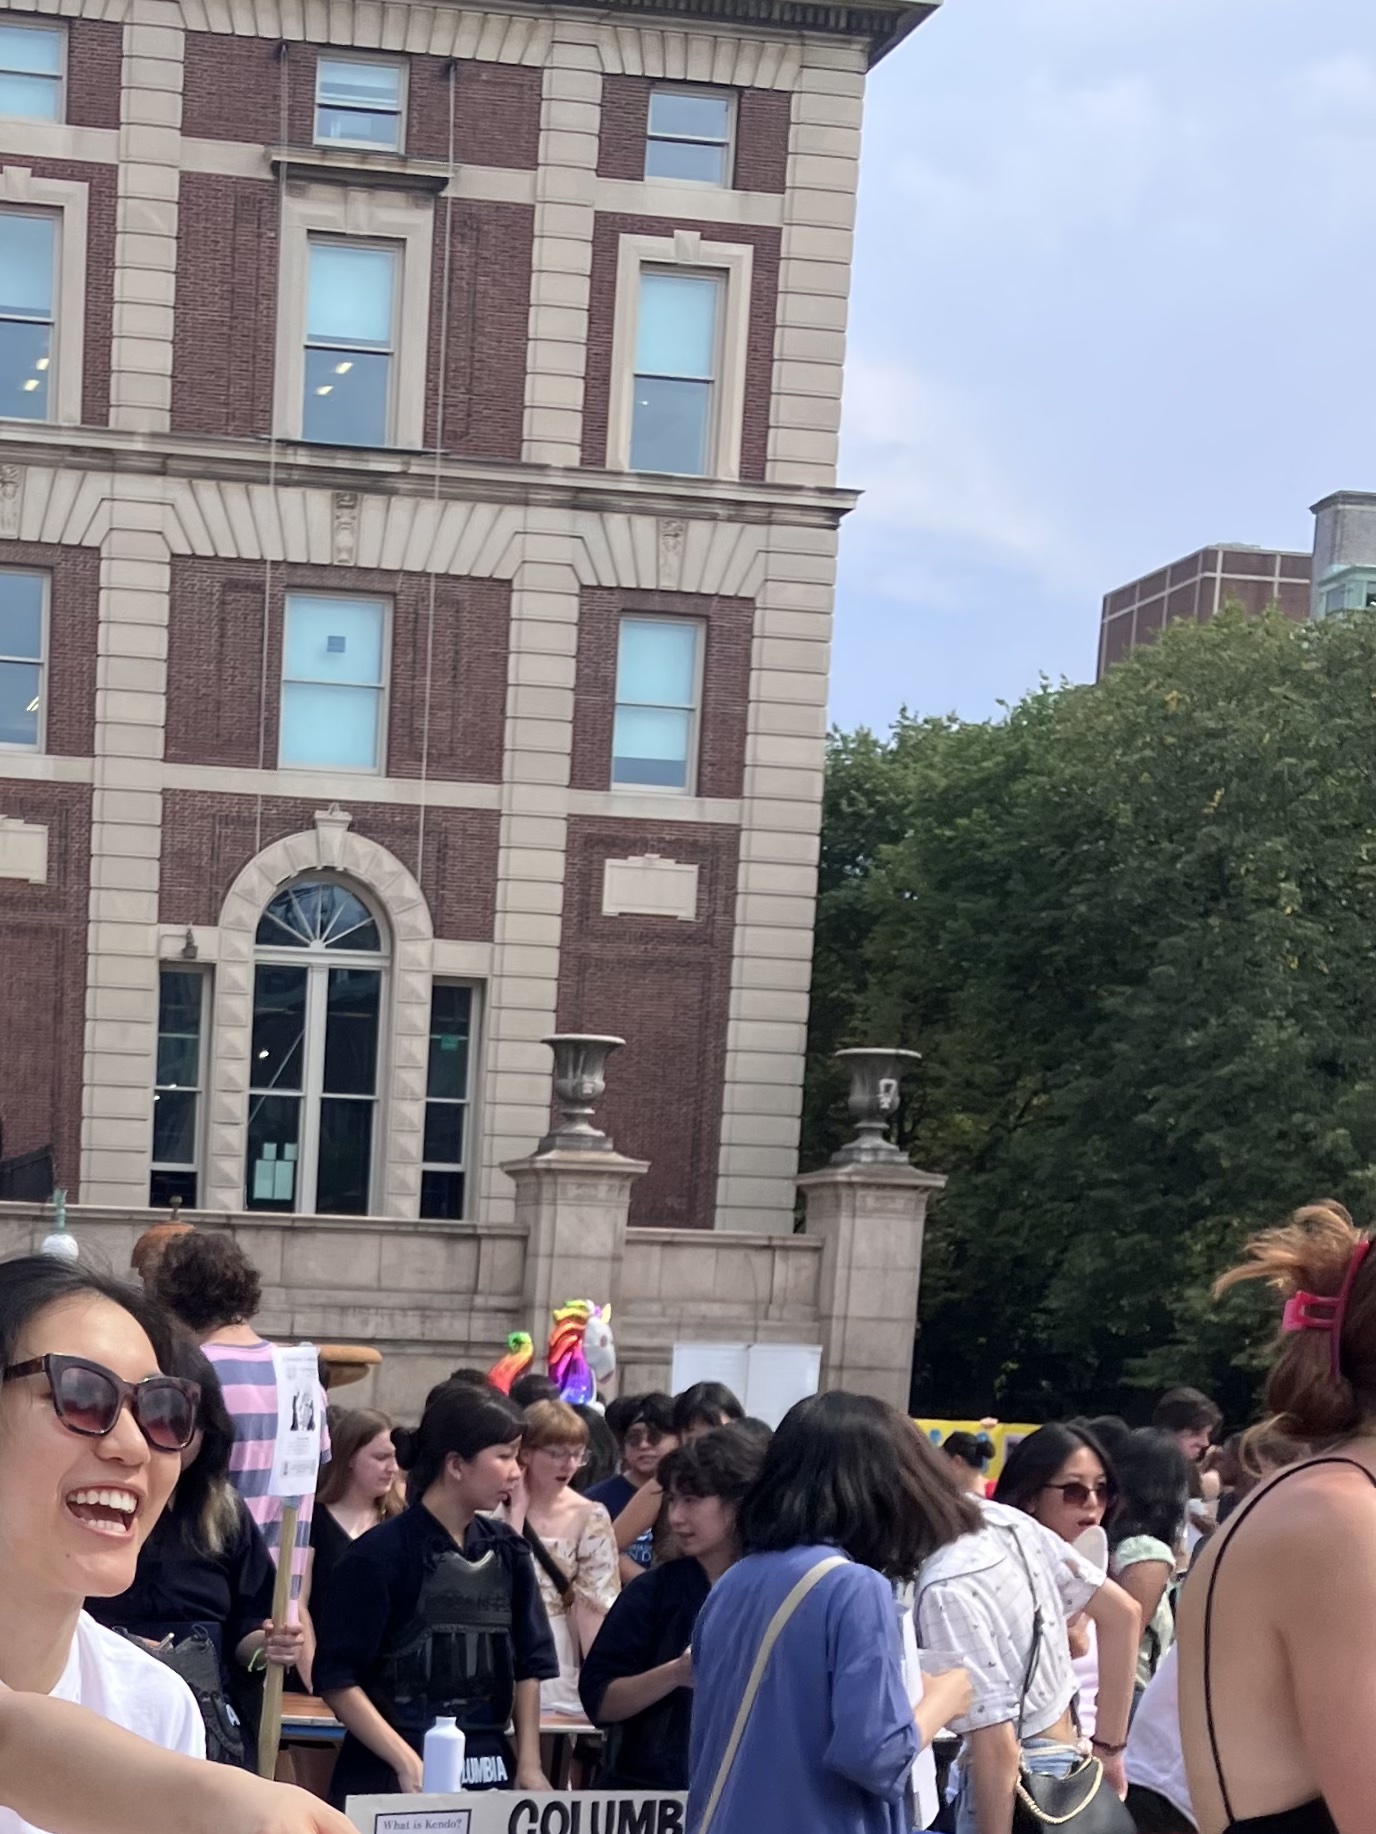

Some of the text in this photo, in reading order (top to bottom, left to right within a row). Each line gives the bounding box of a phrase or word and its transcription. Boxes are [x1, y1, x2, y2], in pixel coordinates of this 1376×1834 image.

[383, 1818, 462, 1830] What is Kendo?
